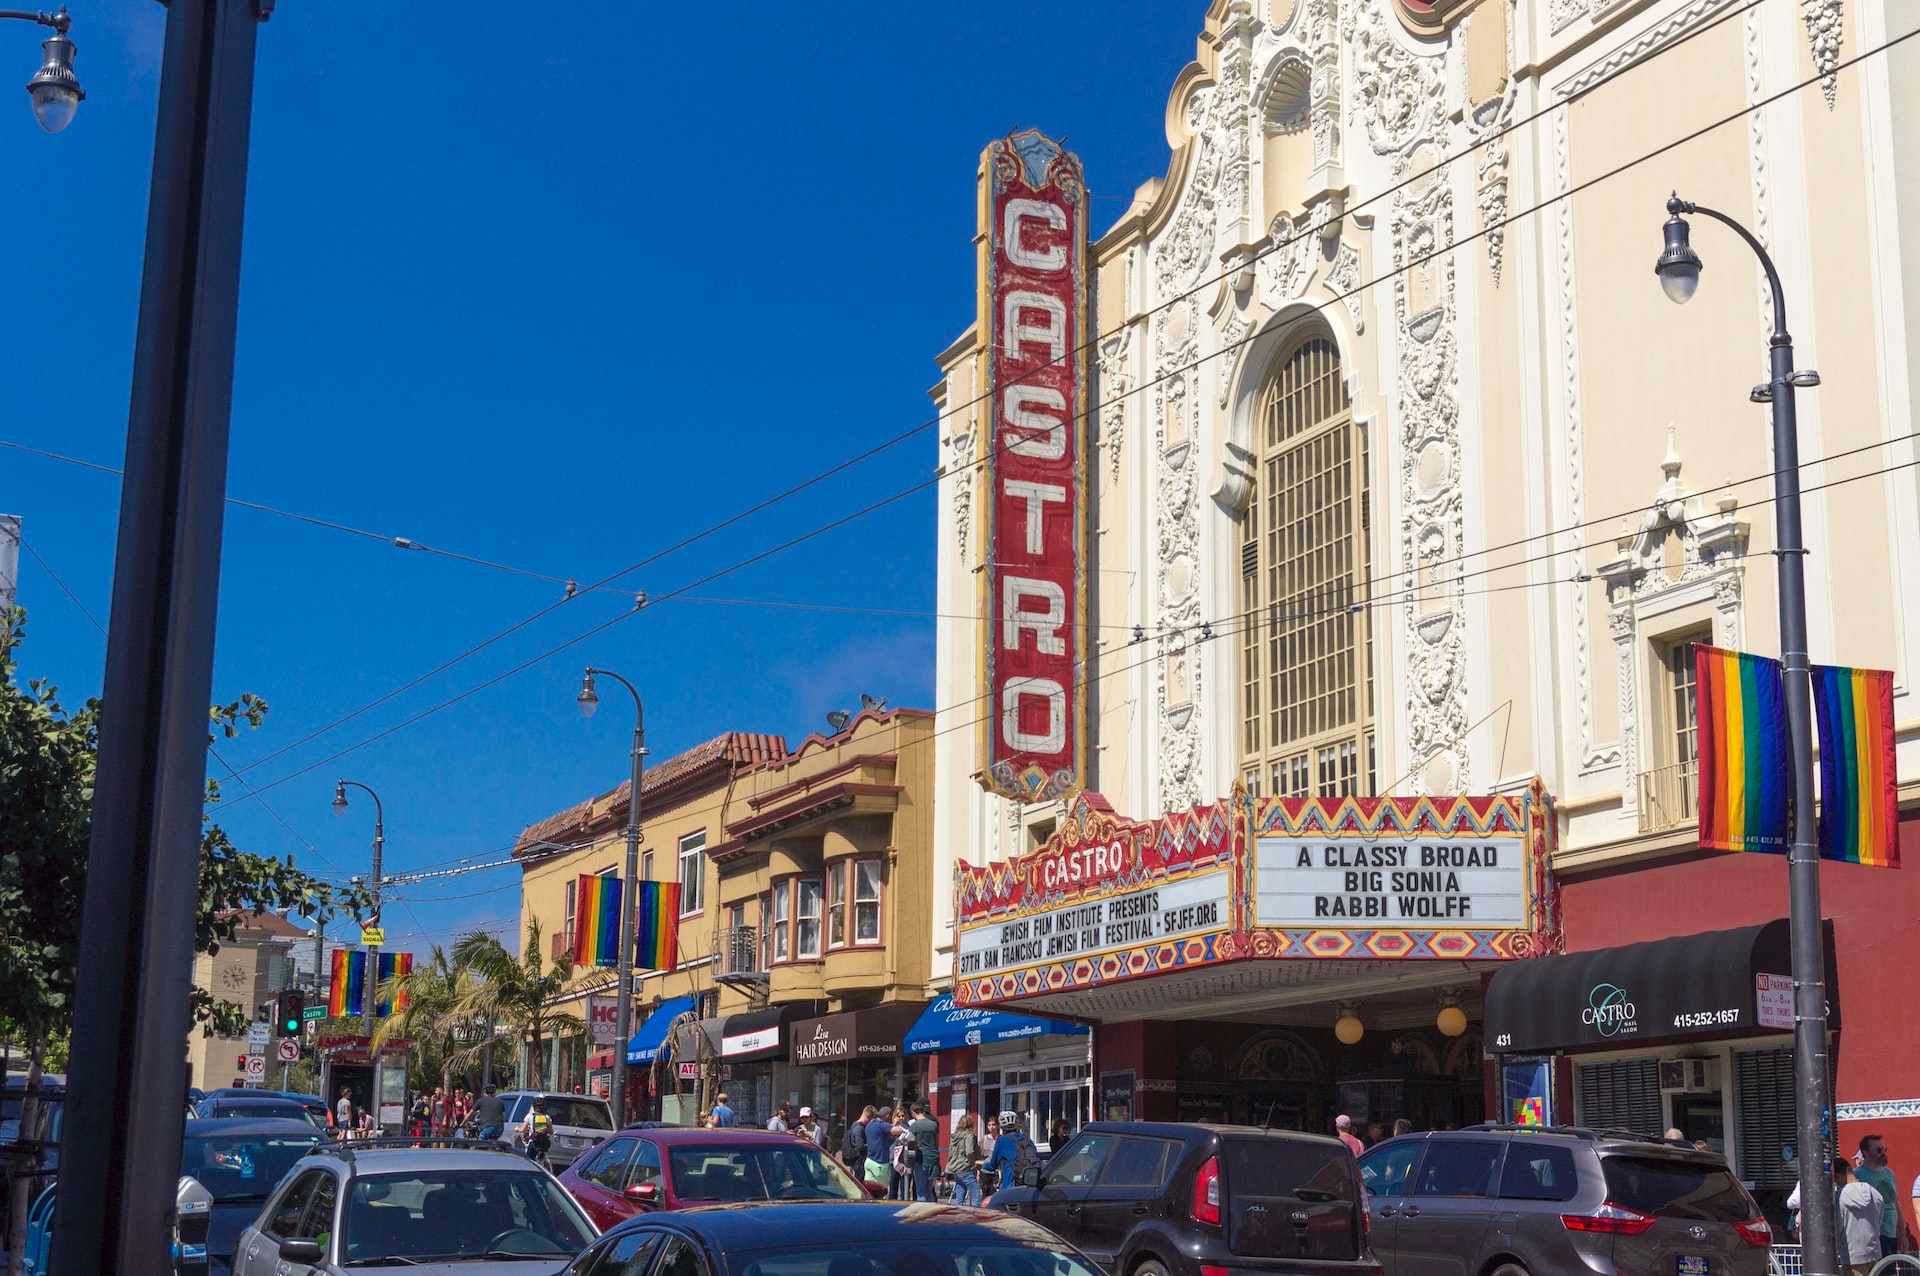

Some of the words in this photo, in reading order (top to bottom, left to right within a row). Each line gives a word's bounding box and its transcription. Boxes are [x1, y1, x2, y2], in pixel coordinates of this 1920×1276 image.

[1003, 198, 1067, 754] CASTRO
[1044, 840, 1123, 888] CASTRO
[1297, 846, 1312, 867] A
[1324, 846, 1408, 867] CLASSY
[1420, 846, 1498, 867] BROAD
[1344, 871, 1383, 892] BIG
[1391, 871, 1460, 892] SONIA
[1315, 896, 1388, 917] RABBI
[1398, 896, 1471, 917] WOLFF
[1000, 919, 1030, 944] JEWISH
[1033, 916, 1051, 938] FILM
[1055, 905, 1103, 933] INSTITUTE
[1108, 892, 1160, 921] PRESENTS
[960, 953, 981, 973] 37TH
[984, 950, 999, 969] SAN
[1001, 940, 1043, 967] FRANCISCO
[1046, 934, 1078, 956] JEWISH
[1081, 929, 1100, 949] FILM
[1105, 919, 1154, 944] FESTIVAL
[1164, 902, 1218, 932] SFJFF.ORG
[1758, 974, 1769, 990] NO
[1770, 980, 1793, 992] PARKING
[933, 996, 956, 1012] CAS
[1582, 1003, 1636, 1025] CASTRO
[1673, 1008, 1740, 1028] 415-252-1657
[813, 1023, 829, 1041] Lisa
[1496, 1033, 1512, 1047] 431
[1620, 1026, 1638, 1034] SALON
[796, 1043, 817, 1060] HAIR
[818, 1038, 848, 1057] DESIGN
